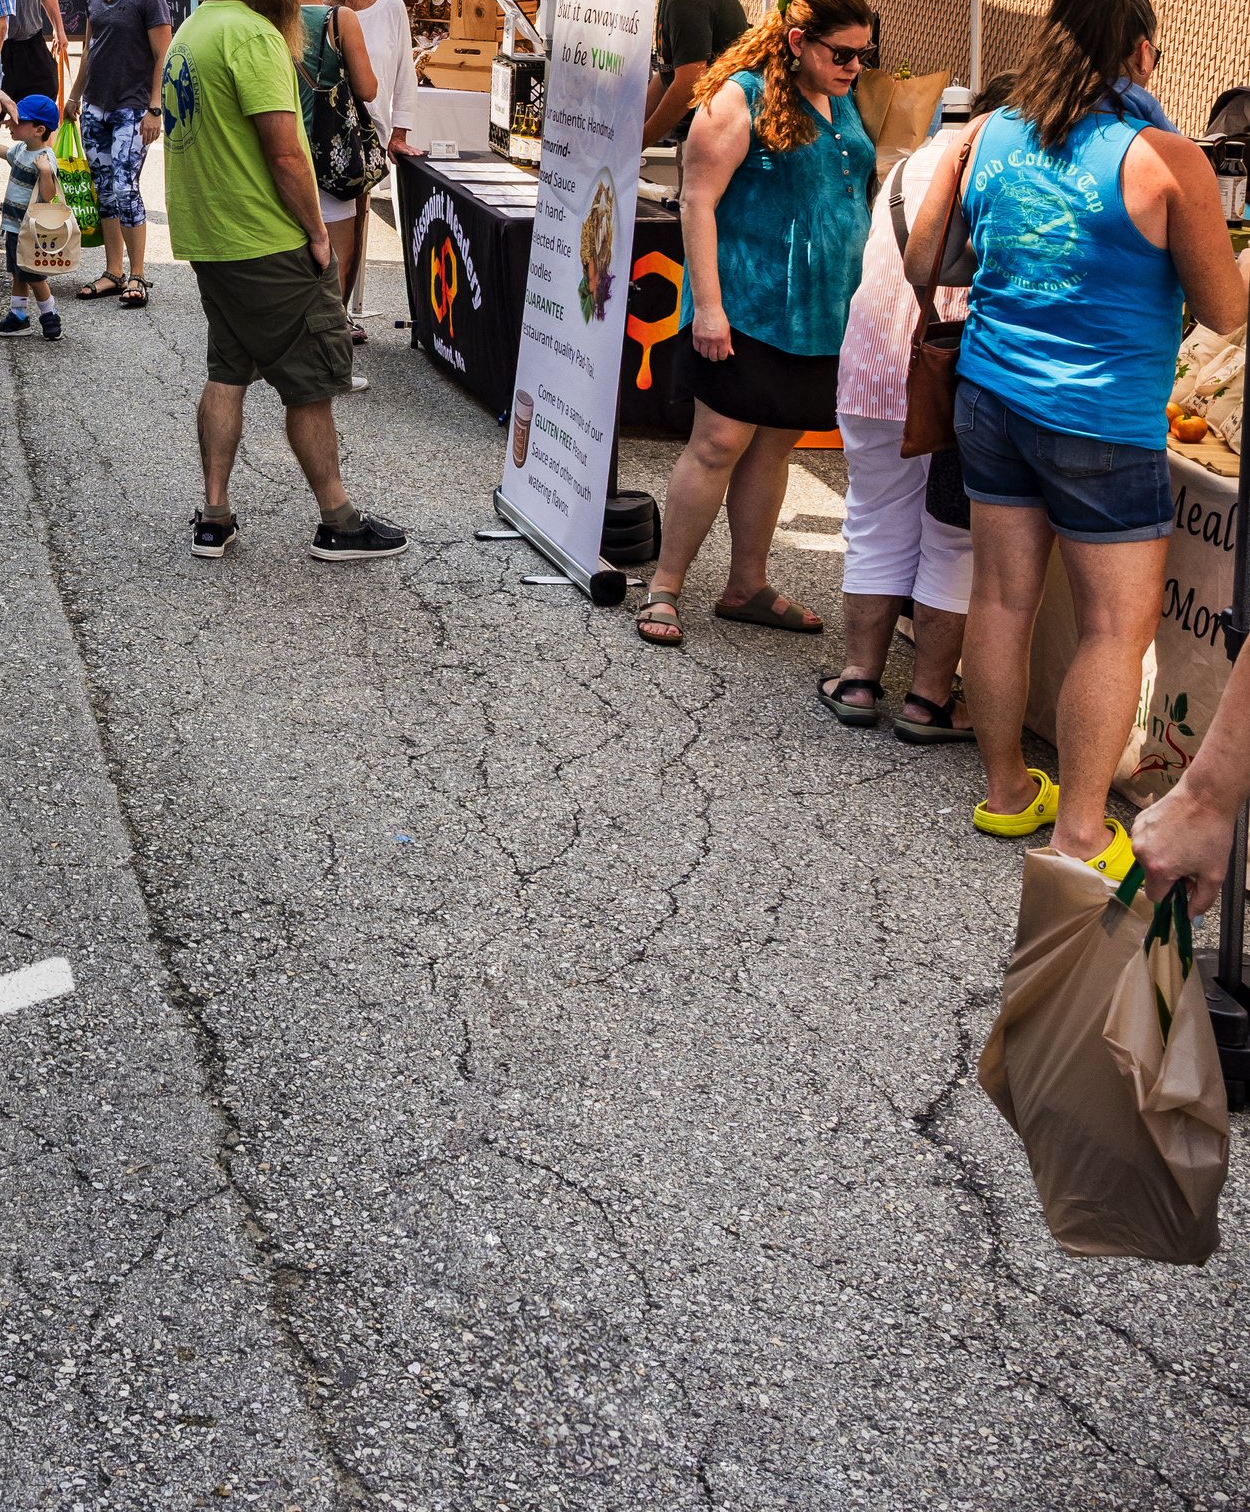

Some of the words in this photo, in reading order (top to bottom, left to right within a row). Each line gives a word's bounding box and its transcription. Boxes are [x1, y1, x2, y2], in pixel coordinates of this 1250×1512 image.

[572, 1, 582, 22] it
[619, 9, 640, 35] needs
[561, 42, 572, 63] to
[573, 41, 588, 66] be
[591, 47, 626, 78] YUMMY!
[553, 108, 587, 130] authentic
[553, 172, 576, 193] Sauce
[974, 158, 1005, 192] Old
[1008, 149, 1079, 178] Colony
[1076, 171, 1105, 213] Tap
[545, 200, 567, 222] hand-
[412, 186, 445, 268] Blisspoint
[446, 194, 483, 312] Meadery
[556, 237, 572, 258] Rice
[553, 338, 576, 365] quality
[537, 384, 556, 407] Come
[556, 396, 566, 416] try
[590, 427, 604, 444] our
[534, 413, 560, 441] GLUTEN
[558, 428, 574, 452] FREE
[572, 440, 588, 467] Peanut
[528, 473, 552, 505] watering
[530, 441, 549, 466] Sauce
[548, 455, 561, 474] and
[559, 466, 574, 487] other
[573, 477, 592, 503] mouth
